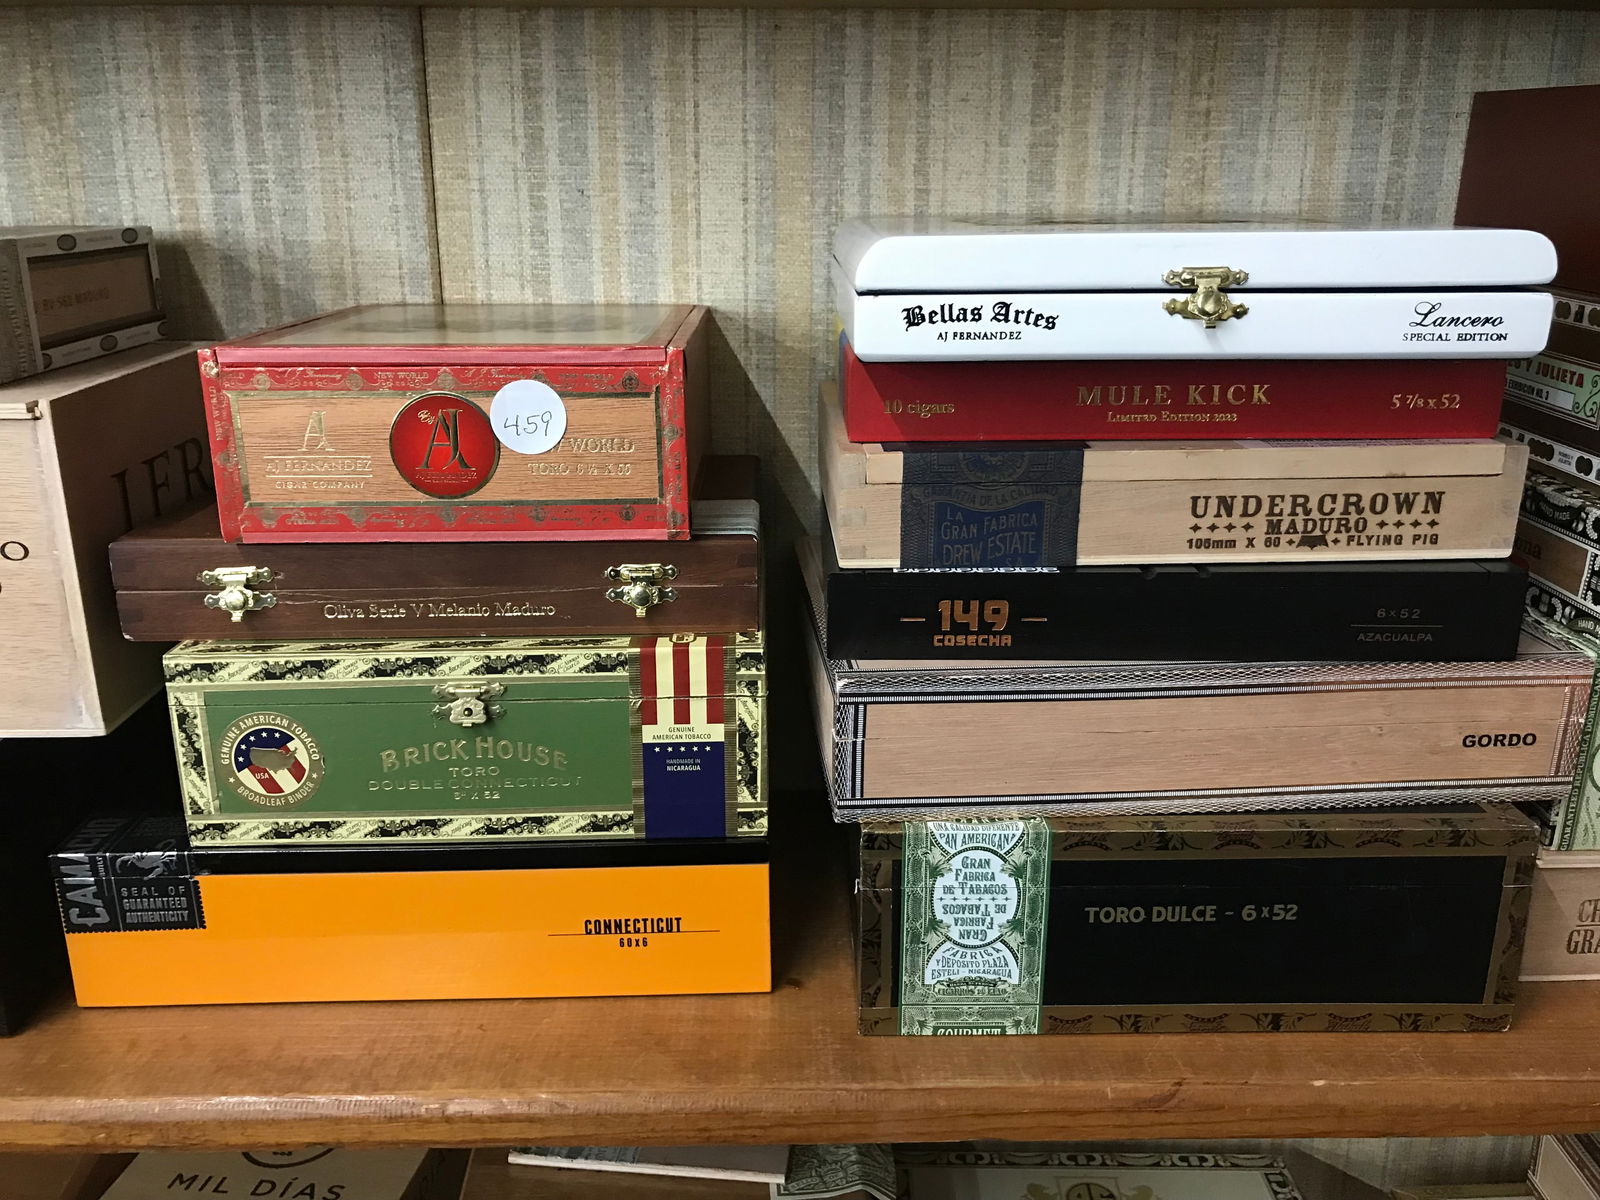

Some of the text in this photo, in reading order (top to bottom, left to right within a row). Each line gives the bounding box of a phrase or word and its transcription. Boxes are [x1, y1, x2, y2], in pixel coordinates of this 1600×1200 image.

[901, 301, 1059, 332] Bellas Artes
[1409, 301, 1504, 327] Lancero
[937, 331, 1022, 342] AJ FERNANDEZ
[1402, 332, 1508, 342] SPECIAL EDITION
[1536, 361, 1585, 388] JULIETA
[1076, 384, 1271, 406] MULE KICK
[1440, 393, 1461, 409] 52
[884, 399, 955, 418] 10 cigars
[1161, 411, 1210, 422] EDITION
[503, 411, 553, 437] 459
[569, 438, 635, 453] WORLD
[285, 460, 373, 472] FERNANDEZ
[528, 463, 570, 475] TORO
[275, 481, 365, 489] CIGAR COMPANY
[1190, 491, 1446, 519] UNDERCROWN
[947, 507, 964, 522] LA
[941, 512, 1038, 541] GRAN FABRICA
[1264, 517, 1368, 535] MADURO
[1346, 533, 1439, 547] FLYING PIG
[943, 531, 1037, 566] DREW ESTATE
[323, 601, 556, 619] Oliva Serie V Melanio Maduro
[938, 599, 1009, 631] 149
[933, 634, 1013, 647] COSECHA
[220, 715, 320, 765] GENUINE AMERICAN TOBACCO
[652, 733, 683, 741] AMERICAN
[1462, 733, 1537, 748] GORDO
[380, 736, 568, 773] BRICK HOUSE
[449, 766, 500, 777] TORO
[368, 780, 444, 791] DOUBLE
[1561, 789, 1580, 851] GUARANTEED
[1573, 734, 1591, 787] REPUBLICA
[237, 781, 315, 807] BROADLEAF BINDER
[933, 822, 1020, 832] UNA CALIDAD DIFERENTE
[939, 833, 957, 851] PAN
[961, 855, 991, 869] GRAN
[954, 868, 996, 882] FABRICA
[121, 886, 186, 897] SEAL OF
[943, 882, 1008, 895] DE TABACOS
[122, 898, 188, 910] GUARANTEED
[942, 903, 991, 916] TABACOS
[126, 911, 189, 924] AUTHENTICITY
[1085, 906, 1147, 923] TORO
[1151, 905, 1217, 922] DULCE
[584, 917, 682, 935] CONNECTICUT
[953, 916, 994, 930] FABRICA
[958, 929, 988, 942] GRAN
[942, 946, 1003, 960] FABRICA
[941, 956, 981, 968] DEPOSITO
[982, 955, 1009, 969] PLAZA
[931, 968, 1012, 980] ESTELI NICARAGUA
[167, 1172, 346, 1200] MIL DÍAS
